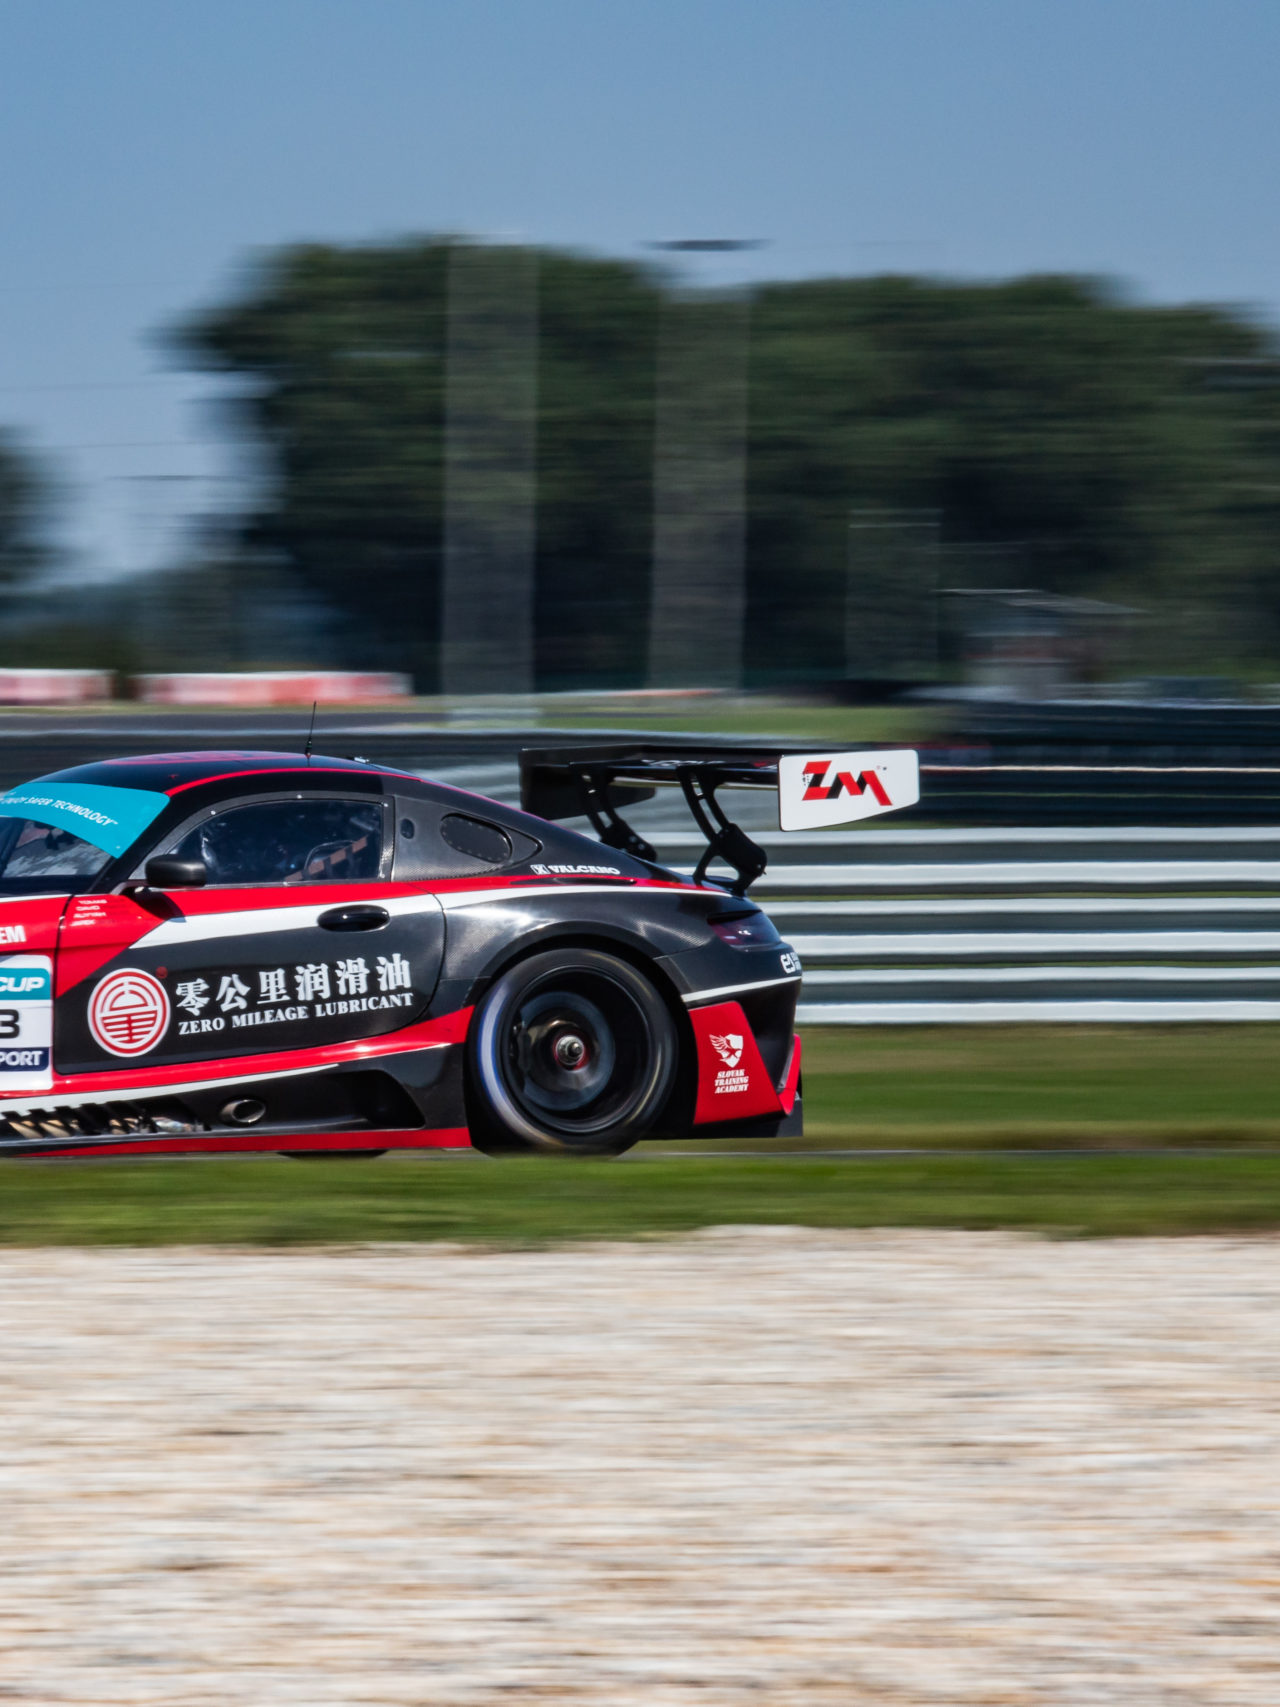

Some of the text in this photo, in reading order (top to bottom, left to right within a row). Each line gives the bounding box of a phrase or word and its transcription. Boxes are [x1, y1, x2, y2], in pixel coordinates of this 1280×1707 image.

[802, 760, 893, 806] ZM
[548, 865, 621, 875] VALCANO
[176, 953, 412, 1016] 零公里润滑油
[178, 992, 414, 1035] ZERO MILEAGE LUBRICANT
[716, 1068, 746, 1079] SLOVAK
[714, 1075, 750, 1087] TRAINING
[714, 1083, 750, 1095] ACADEMY
